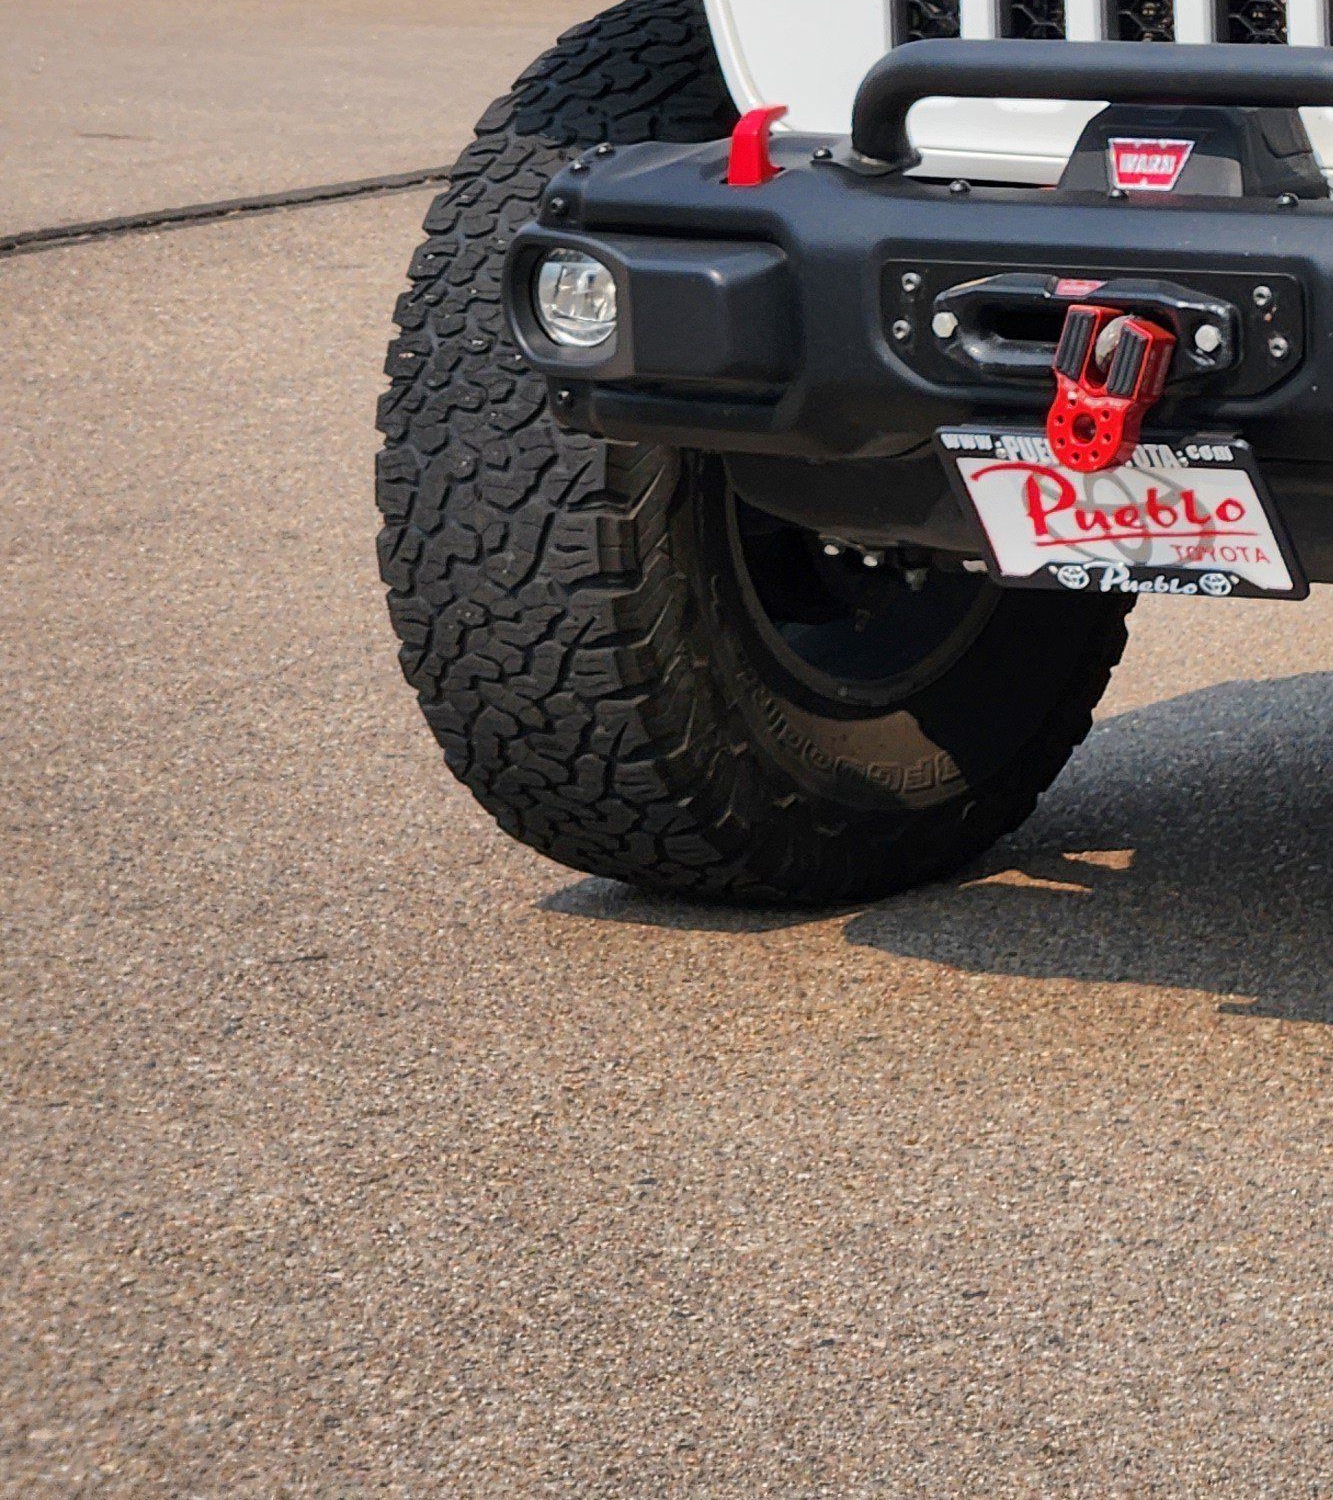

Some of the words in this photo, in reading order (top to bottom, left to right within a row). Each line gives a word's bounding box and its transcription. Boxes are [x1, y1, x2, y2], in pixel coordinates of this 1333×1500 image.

[1118, 153, 1176, 174] WARN
[970, 462, 1246, 537] Pueblo
[1170, 544, 1271, 565] TOYOTA
[1083, 560, 1198, 595] Pueblo
